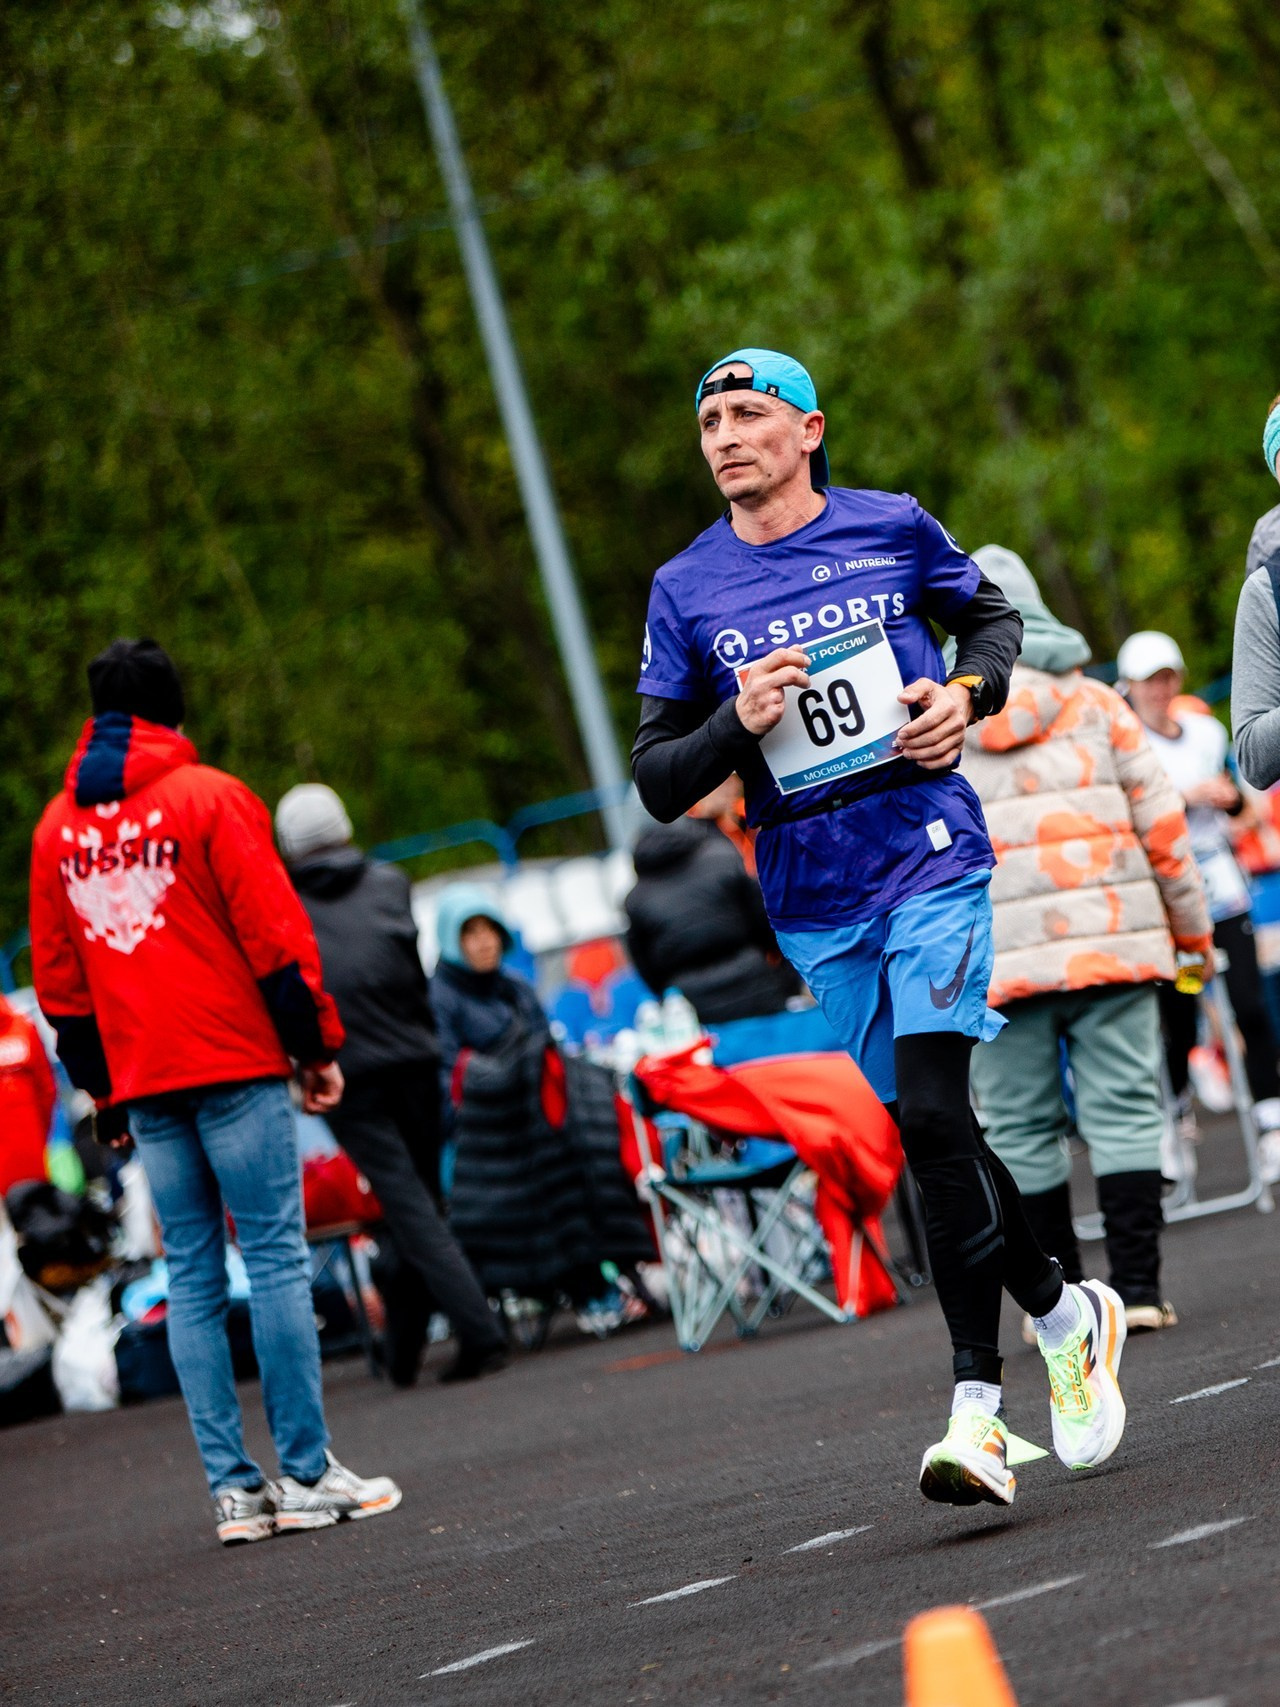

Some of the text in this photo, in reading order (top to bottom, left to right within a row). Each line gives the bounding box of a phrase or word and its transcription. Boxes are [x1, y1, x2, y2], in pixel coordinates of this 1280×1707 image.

[845, 556, 897, 571] NUTREND
[819, 634, 868, 659] РОССИИ
[797, 678, 866, 748] 69
[803, 751, 876, 782] МОСКВА 2024
[59, 835, 180, 884] RUSSIA
